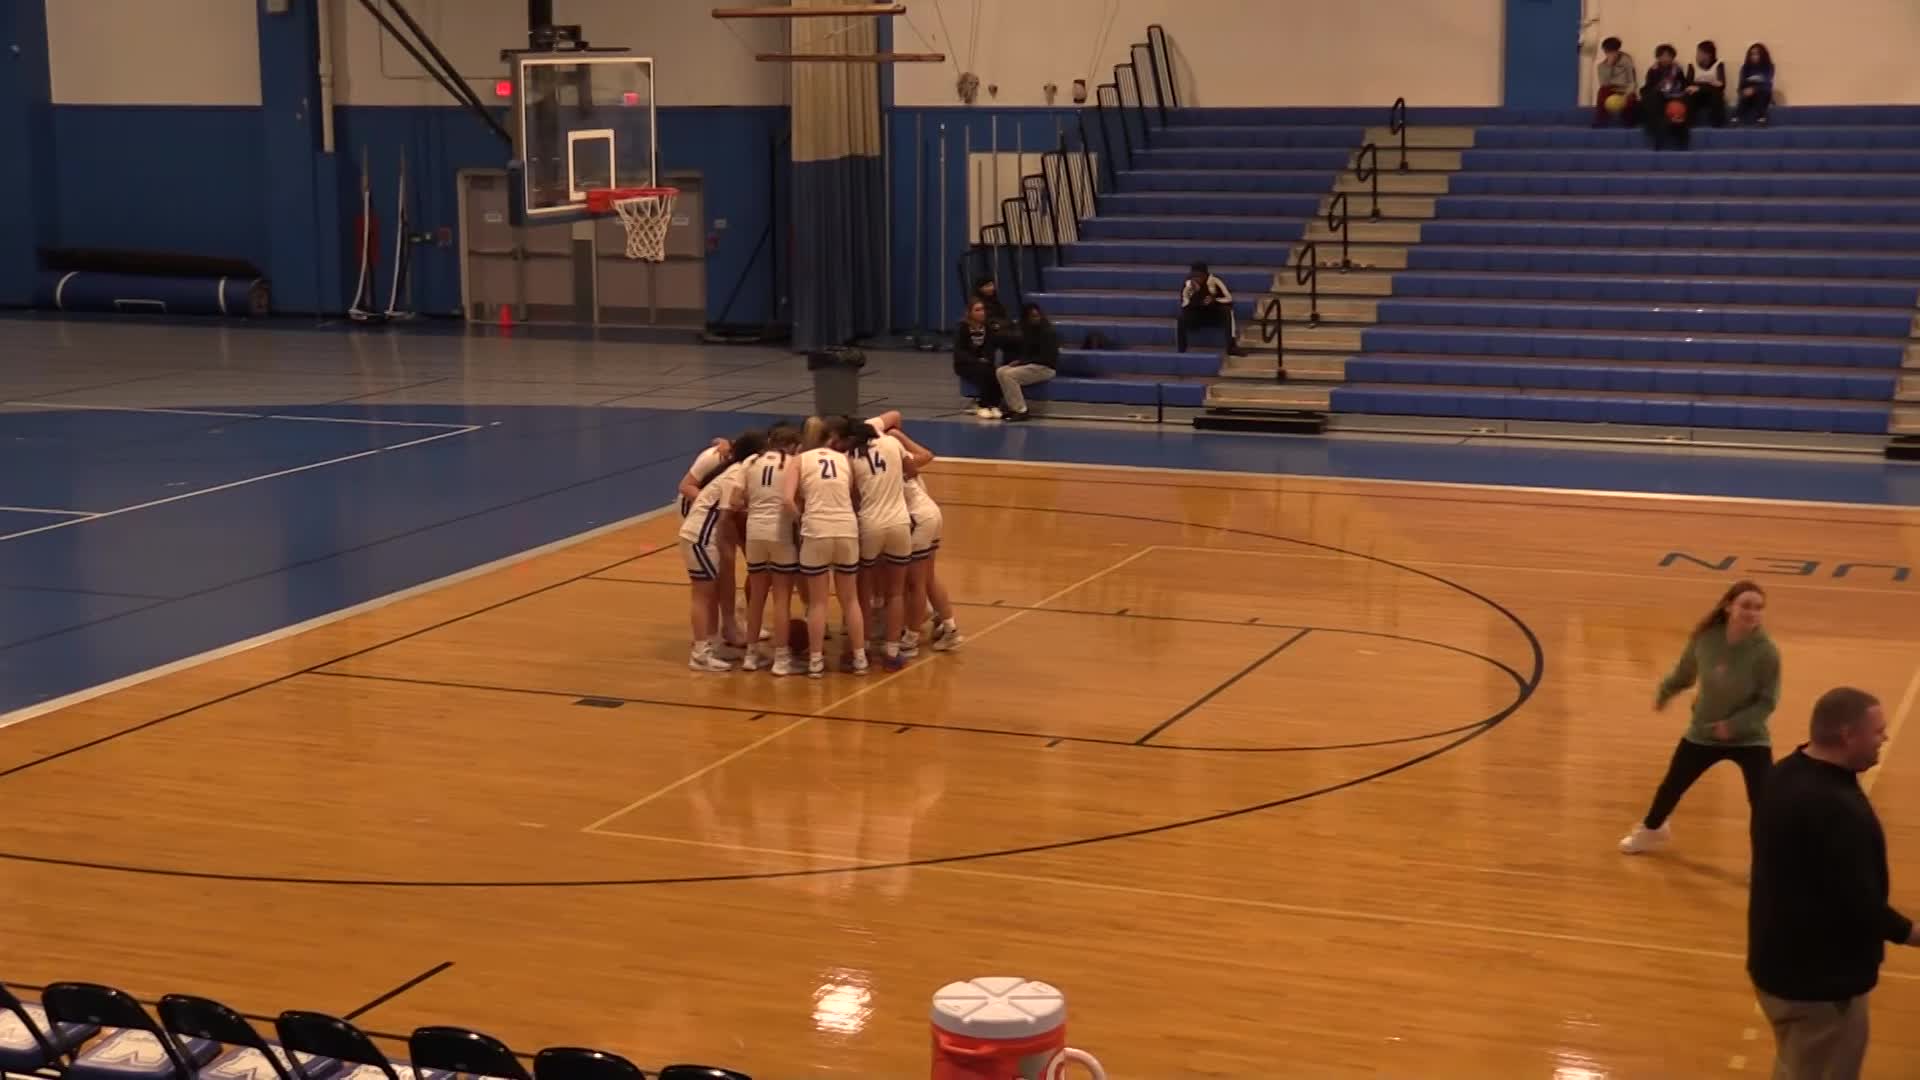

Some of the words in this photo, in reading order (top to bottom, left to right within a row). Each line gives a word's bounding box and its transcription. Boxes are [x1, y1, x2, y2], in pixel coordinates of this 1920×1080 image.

[818, 458, 838, 479] 21
[867, 452, 887, 475] 14
[761, 466, 774, 486] 11
